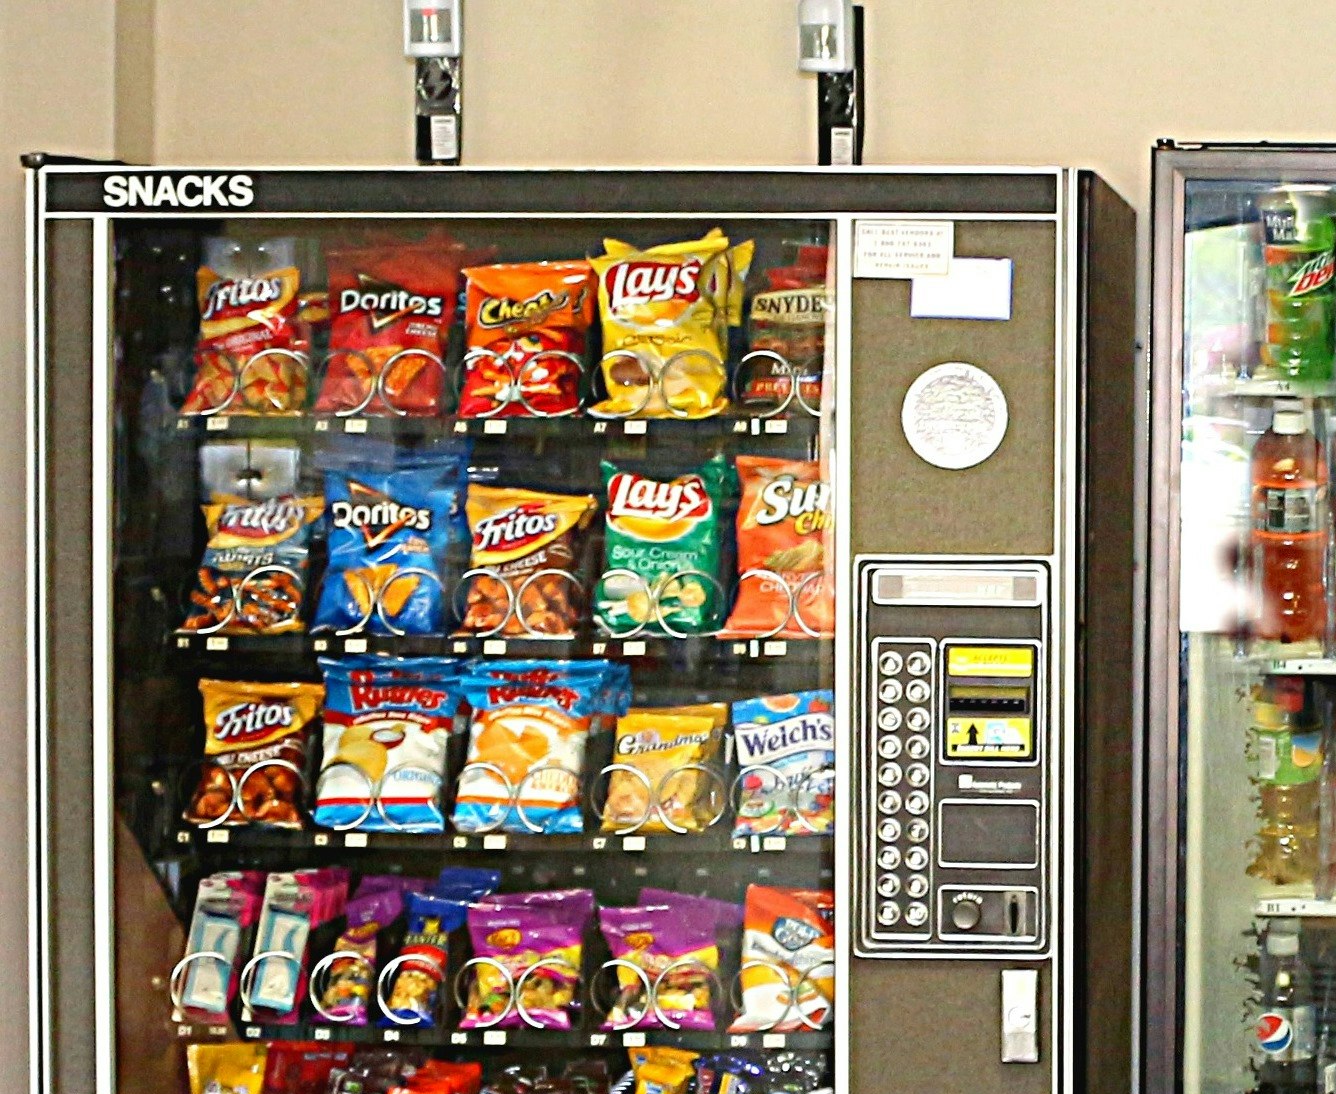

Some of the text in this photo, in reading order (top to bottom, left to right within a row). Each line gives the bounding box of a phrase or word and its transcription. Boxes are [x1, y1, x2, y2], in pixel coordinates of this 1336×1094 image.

[103, 175, 254, 207] SNACKS
[610, 259, 702, 308] Lay's
[340, 289, 442, 316] Doritos
[332, 502, 431, 529] Doritos
[612, 473, 704, 521] Lay's
[476, 505, 556, 550] Fritos
[612, 545, 645, 561] Sour
[215, 702, 294, 739] Fritos
[741, 718, 832, 757] Welch's
